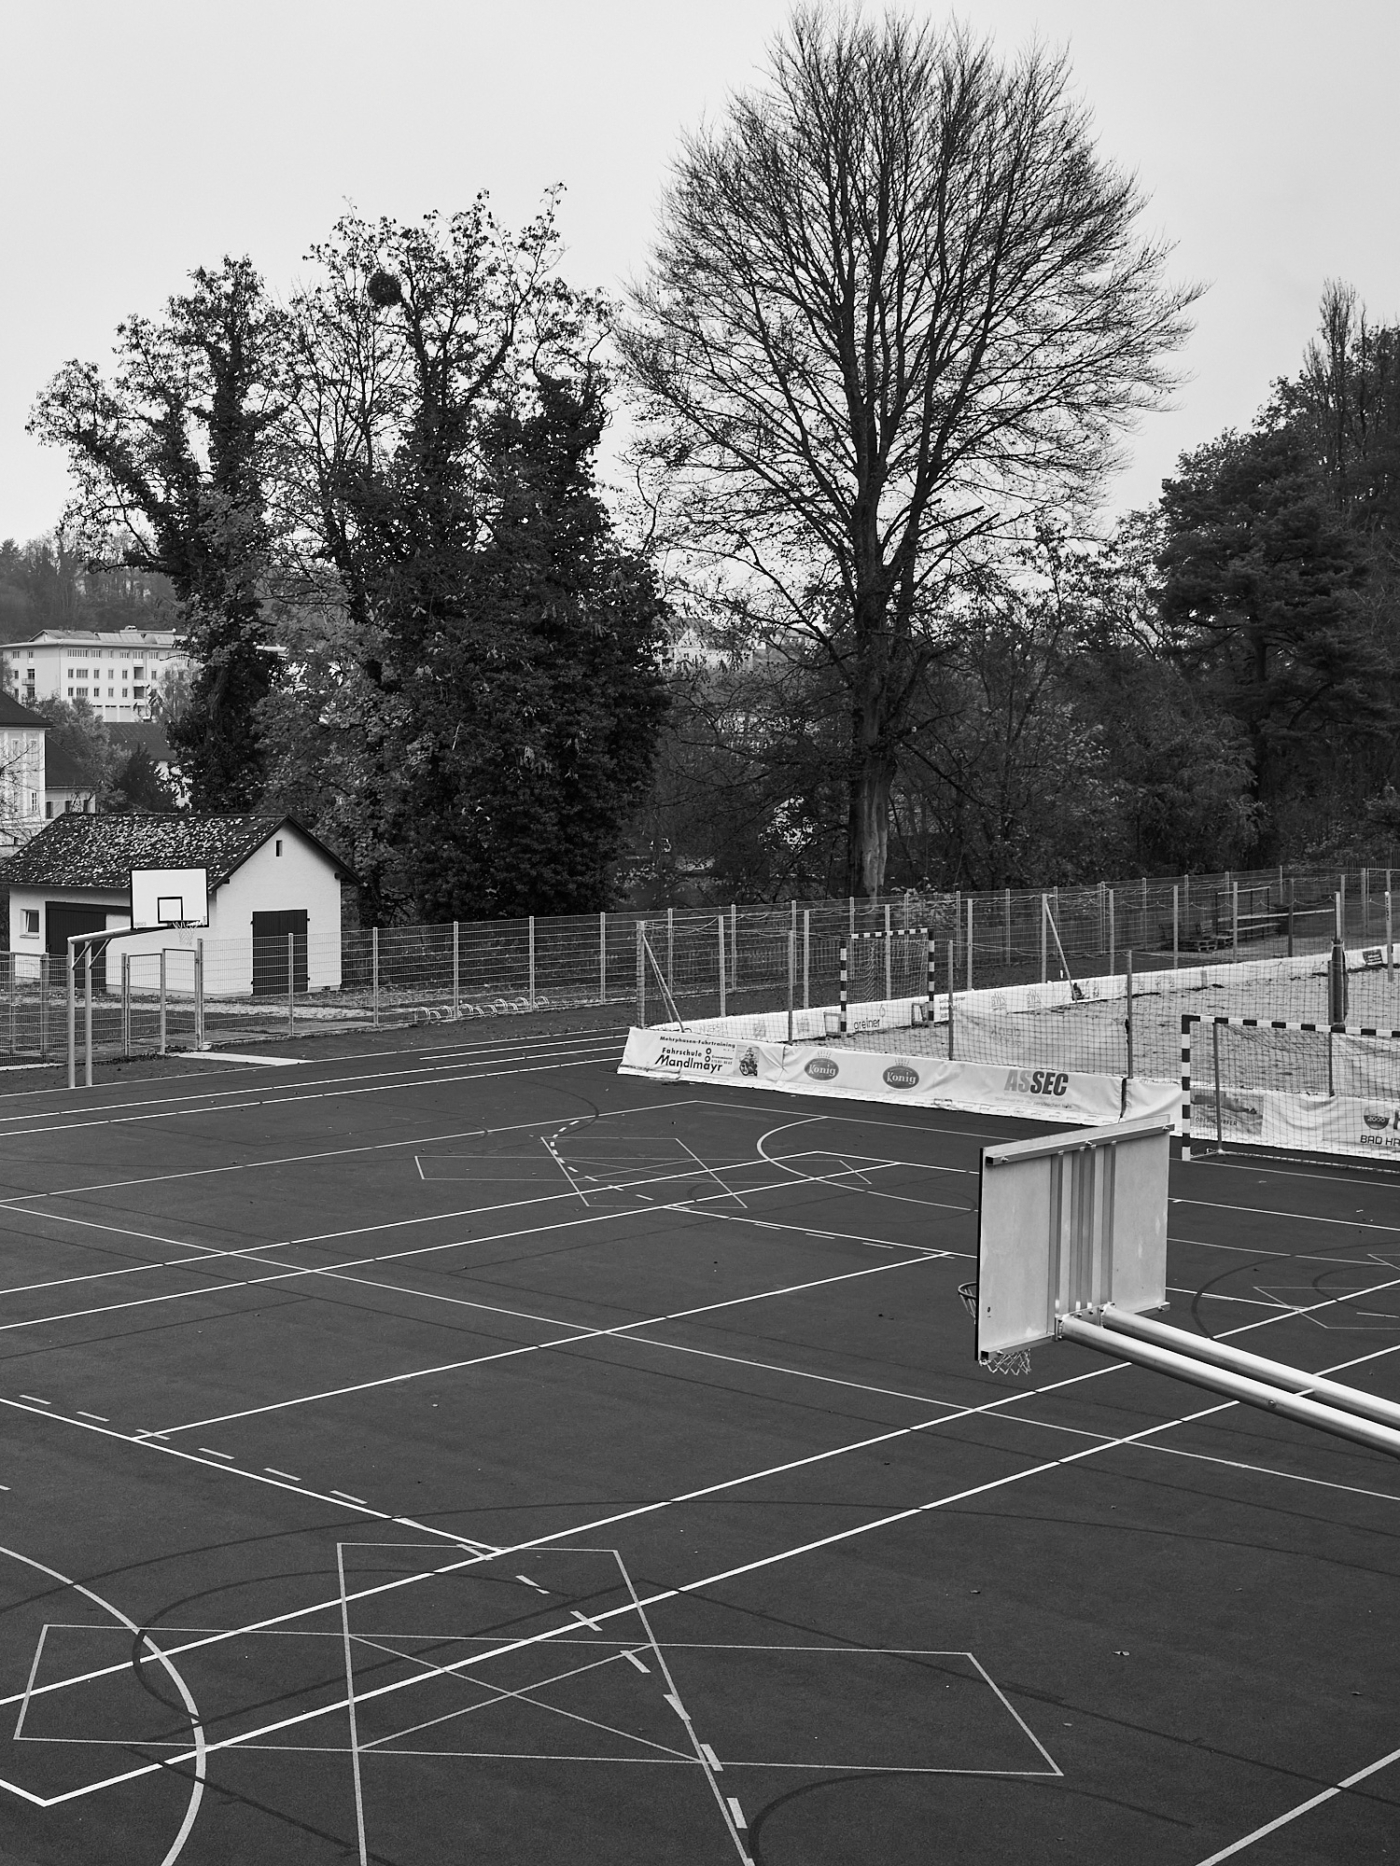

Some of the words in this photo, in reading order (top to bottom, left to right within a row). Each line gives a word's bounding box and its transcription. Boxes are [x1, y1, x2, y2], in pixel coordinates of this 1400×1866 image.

[662, 1047, 702, 1057] Fahrschule
[655, 1054, 723, 1074] Mandlmayr
[1003, 1069, 1069, 1096] ASSEC
[1360, 1134, 1383, 1145] BAD
